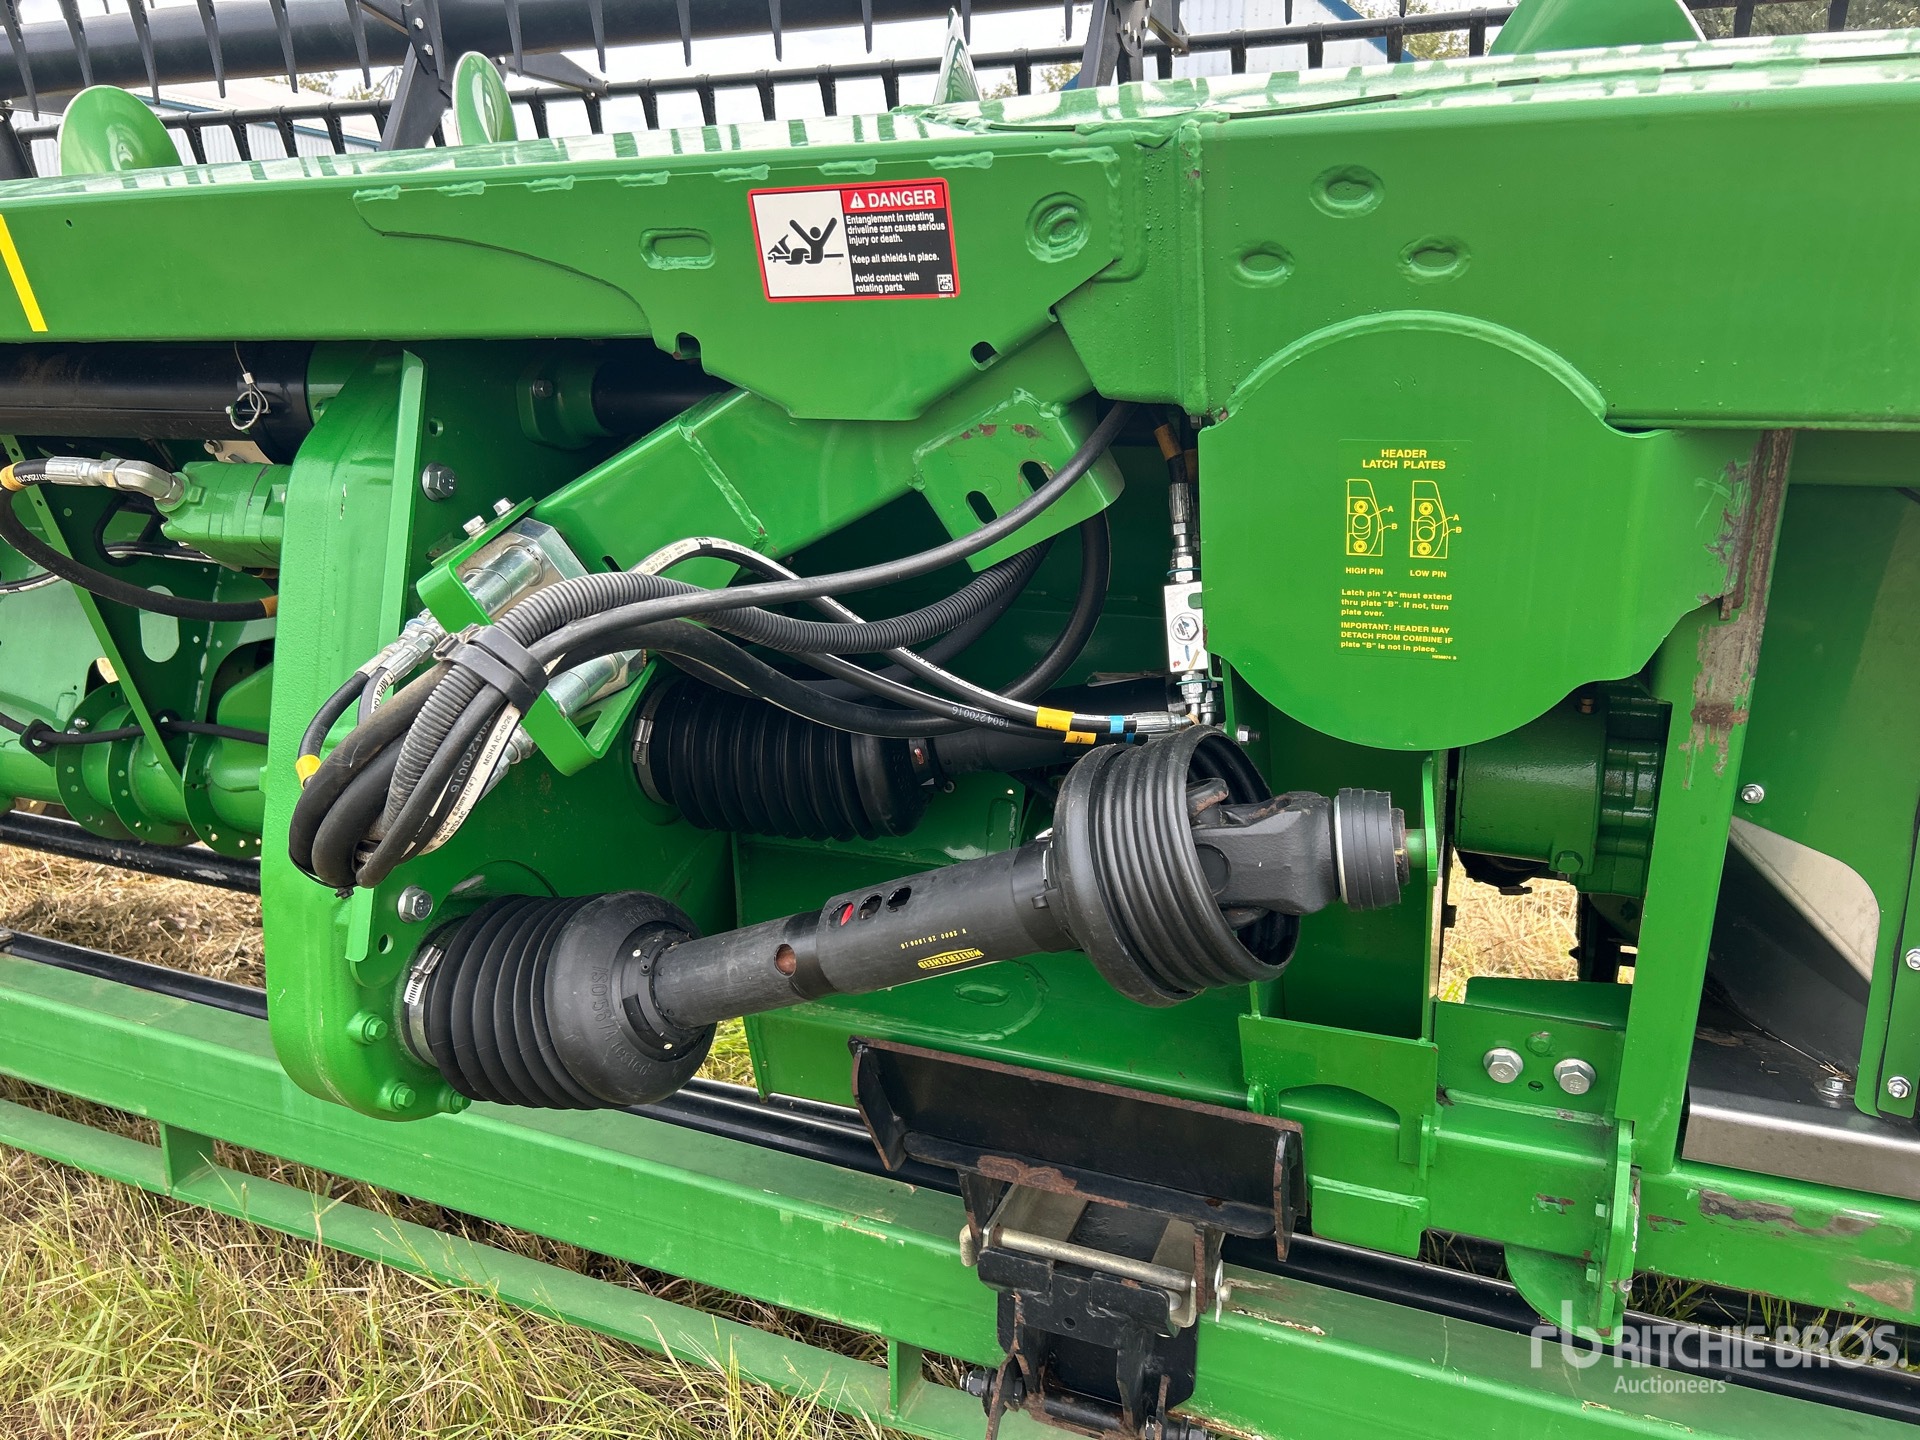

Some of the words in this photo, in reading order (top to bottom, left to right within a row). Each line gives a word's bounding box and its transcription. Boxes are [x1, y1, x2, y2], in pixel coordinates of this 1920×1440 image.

[868, 189, 936, 208] DANGER
[846, 215, 895, 225] Entanglement
[905, 212, 934, 222] rotating
[848, 225, 878, 234] driveline
[918, 222, 945, 231] serious
[849, 236, 869, 246] injury
[880, 235, 902, 243] death.
[852, 255, 870, 265] Keep
[872, 254, 880, 262] all
[882, 254, 907, 262] shields
[917, 253, 940, 262] place.
[855, 274, 875, 282] Avoid
[876, 273, 903, 282] contact
[904, 272, 919, 281] with
[856, 283, 883, 293] rotating
[885, 283, 905, 293] parts.
[1382, 449, 1427, 458] HEADER
[1362, 460, 1398, 469] LATCH
[1404, 461, 1446, 469] PLATES
[1341, 622, 1391, 631] IMPORTANT:
[1403, 635, 1442, 643] COMBINE
[483, 745, 498, 766] MSHA
[918, 949, 985, 968] WALTERSCHEID
[591, 966, 608, 997] ISO
